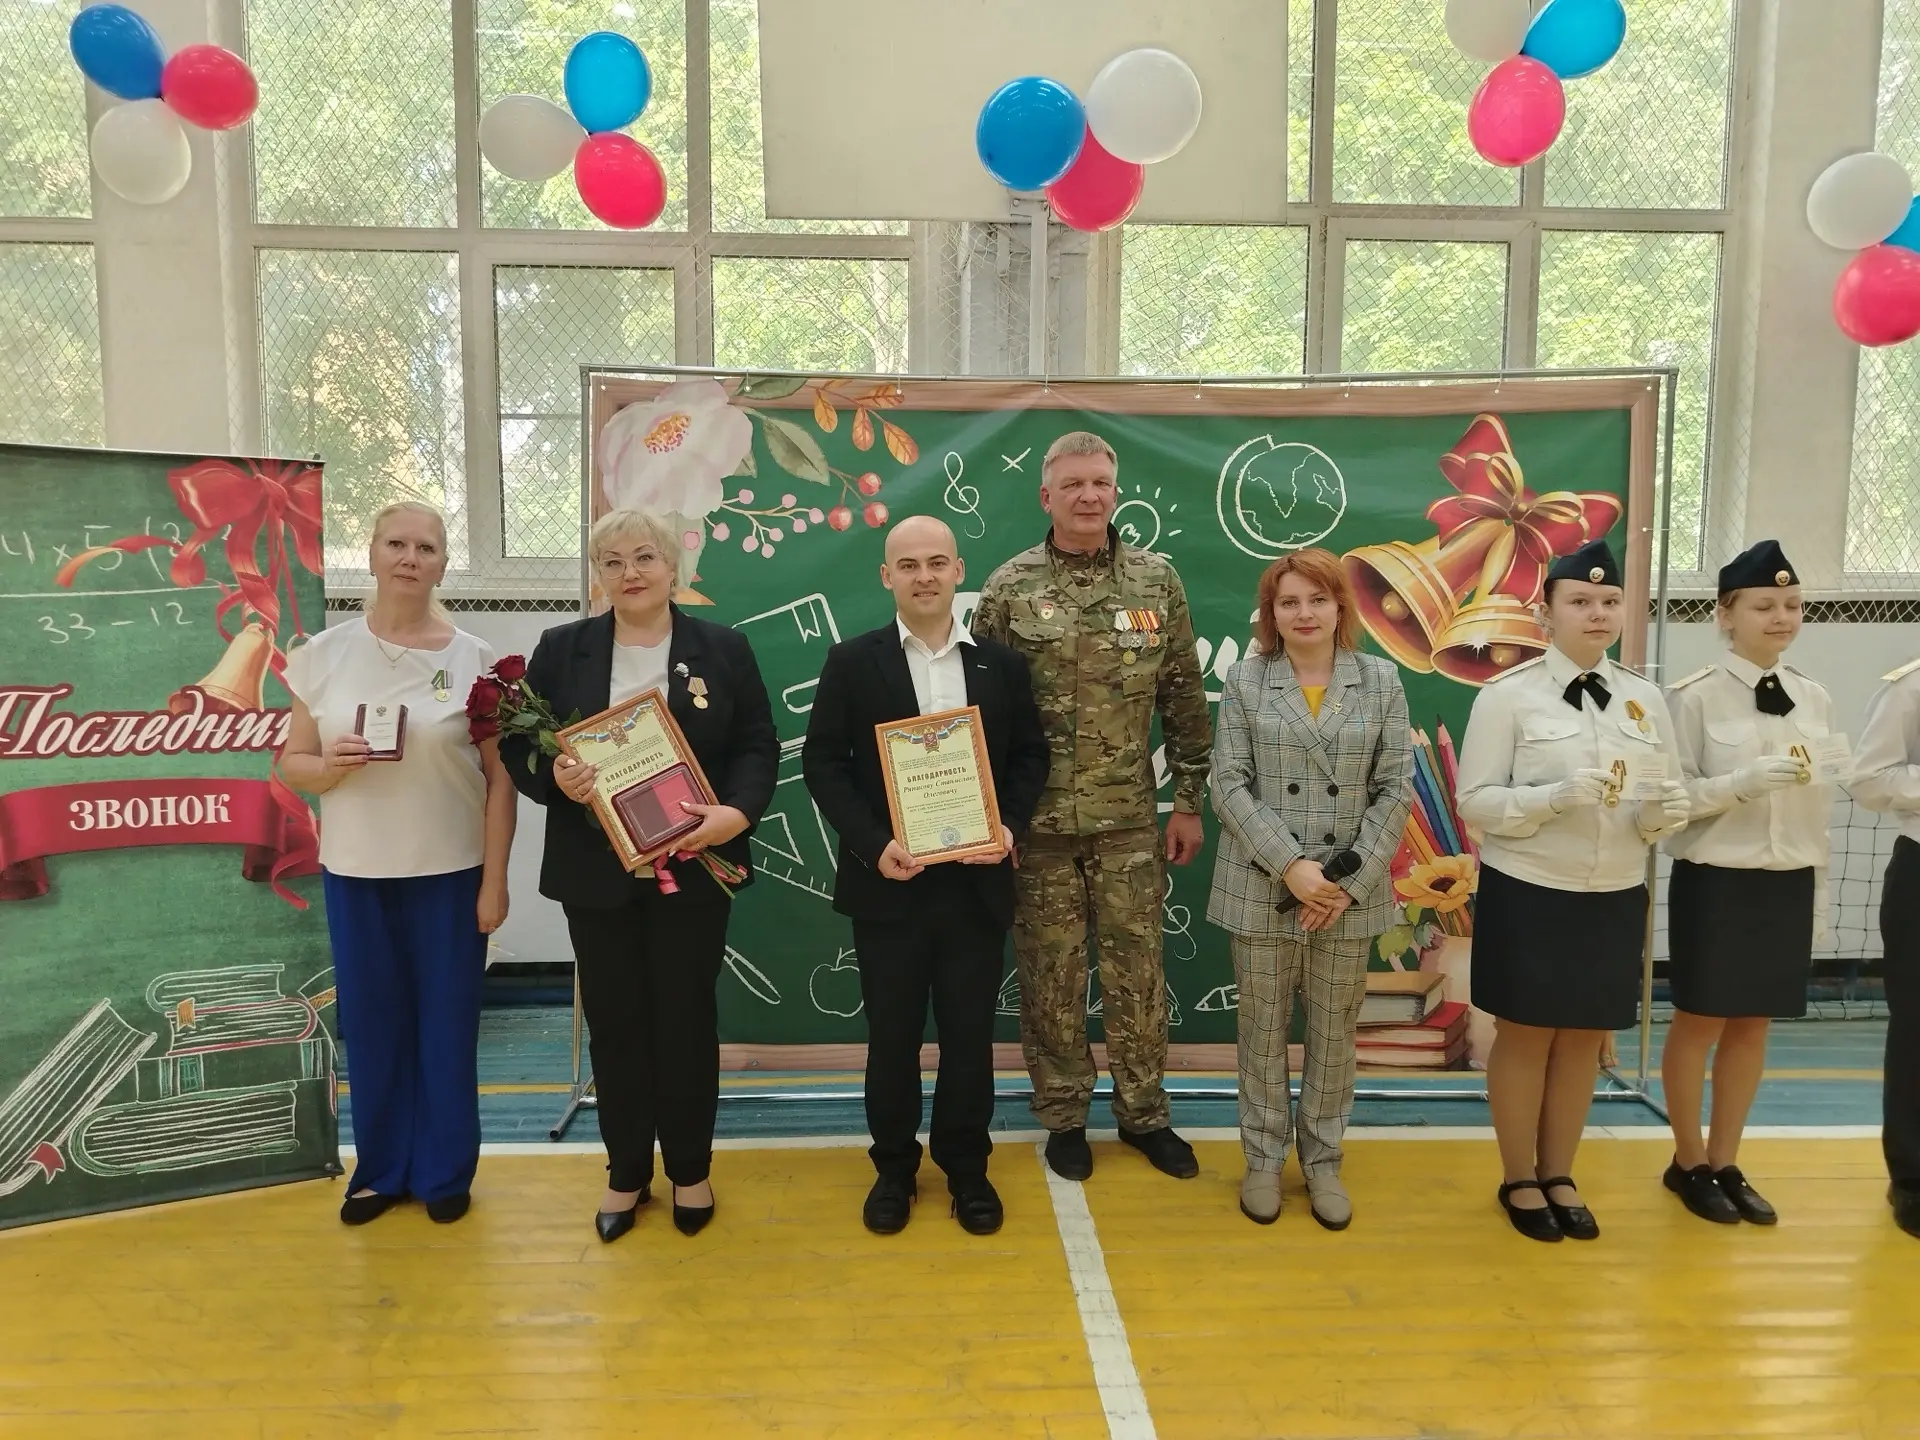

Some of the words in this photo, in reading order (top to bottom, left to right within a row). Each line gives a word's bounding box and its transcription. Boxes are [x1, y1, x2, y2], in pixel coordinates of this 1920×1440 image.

[605, 751, 664, 783] БЛАГОДАРНОСТЬ
[906, 766, 967, 783] БЛАГОДАРНОСТЬ
[69, 793, 232, 831] ЗВОНОК
